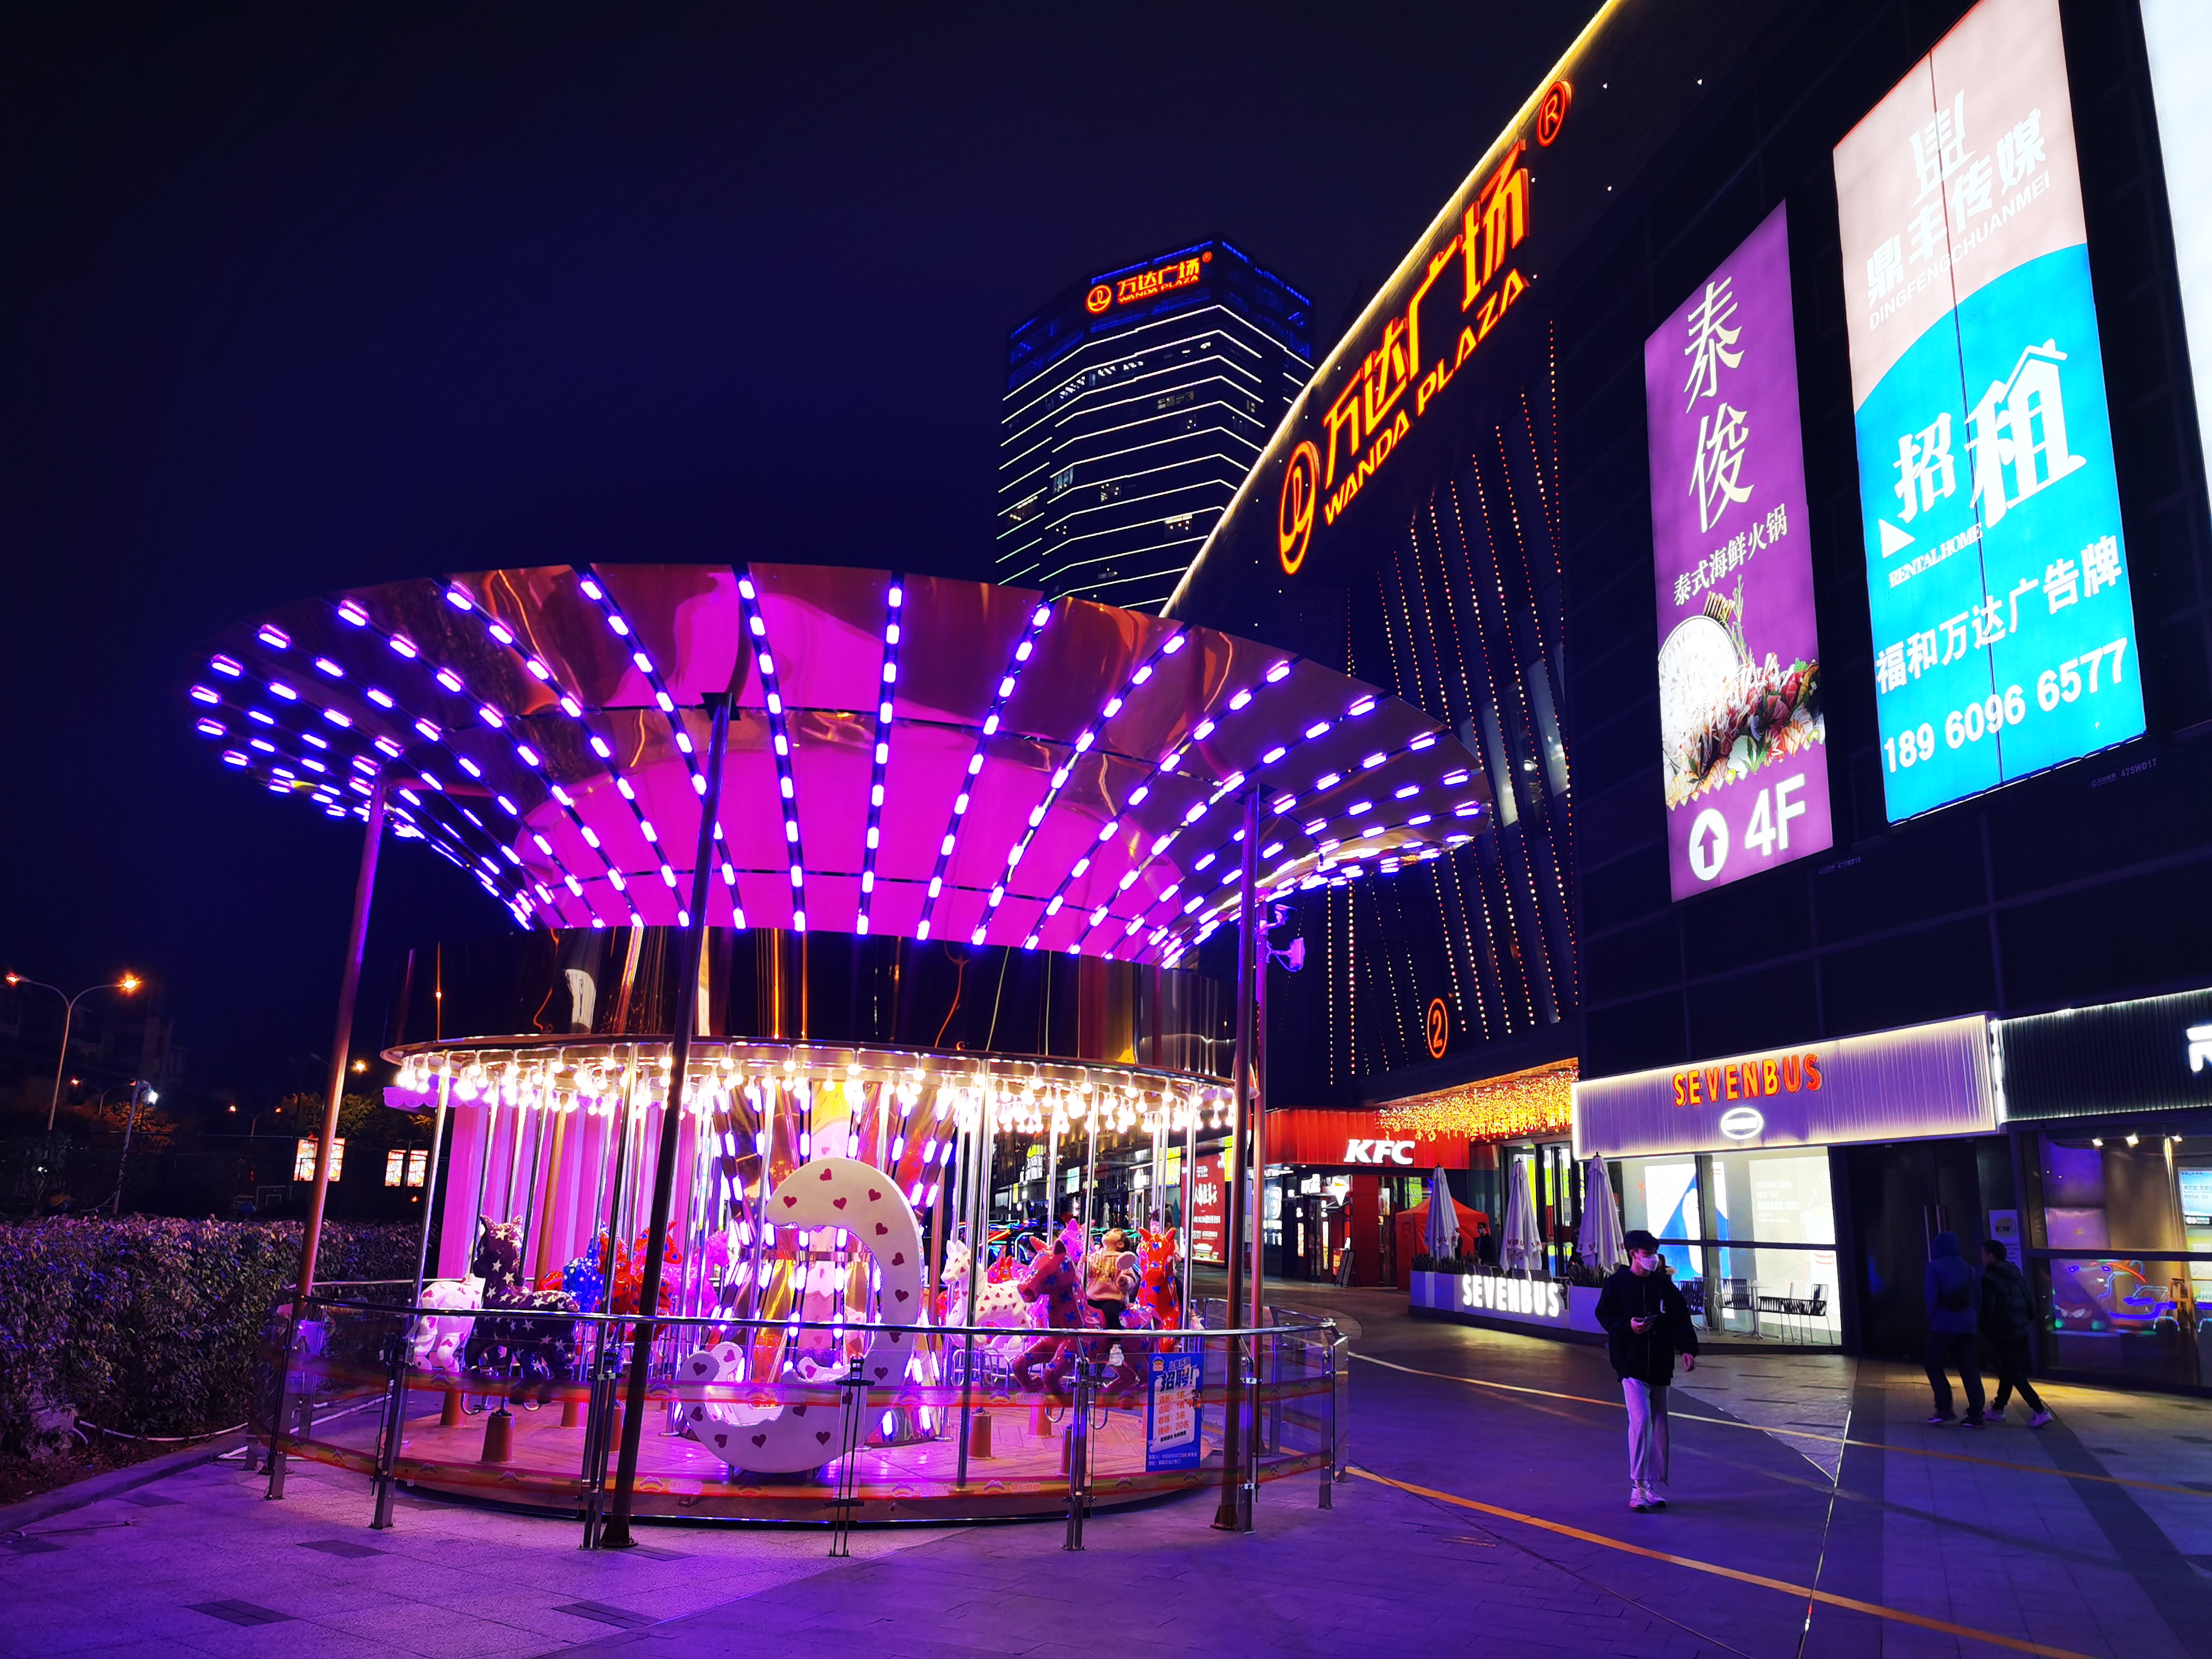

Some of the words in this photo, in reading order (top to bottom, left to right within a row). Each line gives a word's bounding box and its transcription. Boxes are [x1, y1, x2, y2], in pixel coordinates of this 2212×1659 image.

[1866, 108, 2046, 307] 鼎丰传媒
[1869, 170, 2050, 330] DINGFENGCHUANMEI
[1118, 257, 1200, 296] 万达广场
[1119, 287, 1158, 304] WANDA
[1161, 275, 1199, 291] PLAZA
[1323, 139, 1529, 489] 万达广场
[1324, 410, 1410, 526] WANDA
[1417, 269, 1528, 417] PLAZA
[1684, 276, 1754, 534] 泰俊
[1893, 338, 2086, 528] 招租
[1674, 503, 1788, 606] 泰式海鲜火锅
[1889, 548, 1942, 588] RENTAL
[1939, 521, 1983, 564] HOME
[1877, 535, 2122, 694] 福和万达广告牌
[1884, 723, 1935, 773] 189
[1945, 685, 2026, 749] 6096
[2037, 637, 2128, 712] 6577
[1744, 773, 1806, 857] 4F
[1672, 1053, 1822, 1107] SEVENBUS
[1344, 1138, 1415, 1165] KFC
[1462, 1274, 1560, 1318] SEVENBUS
